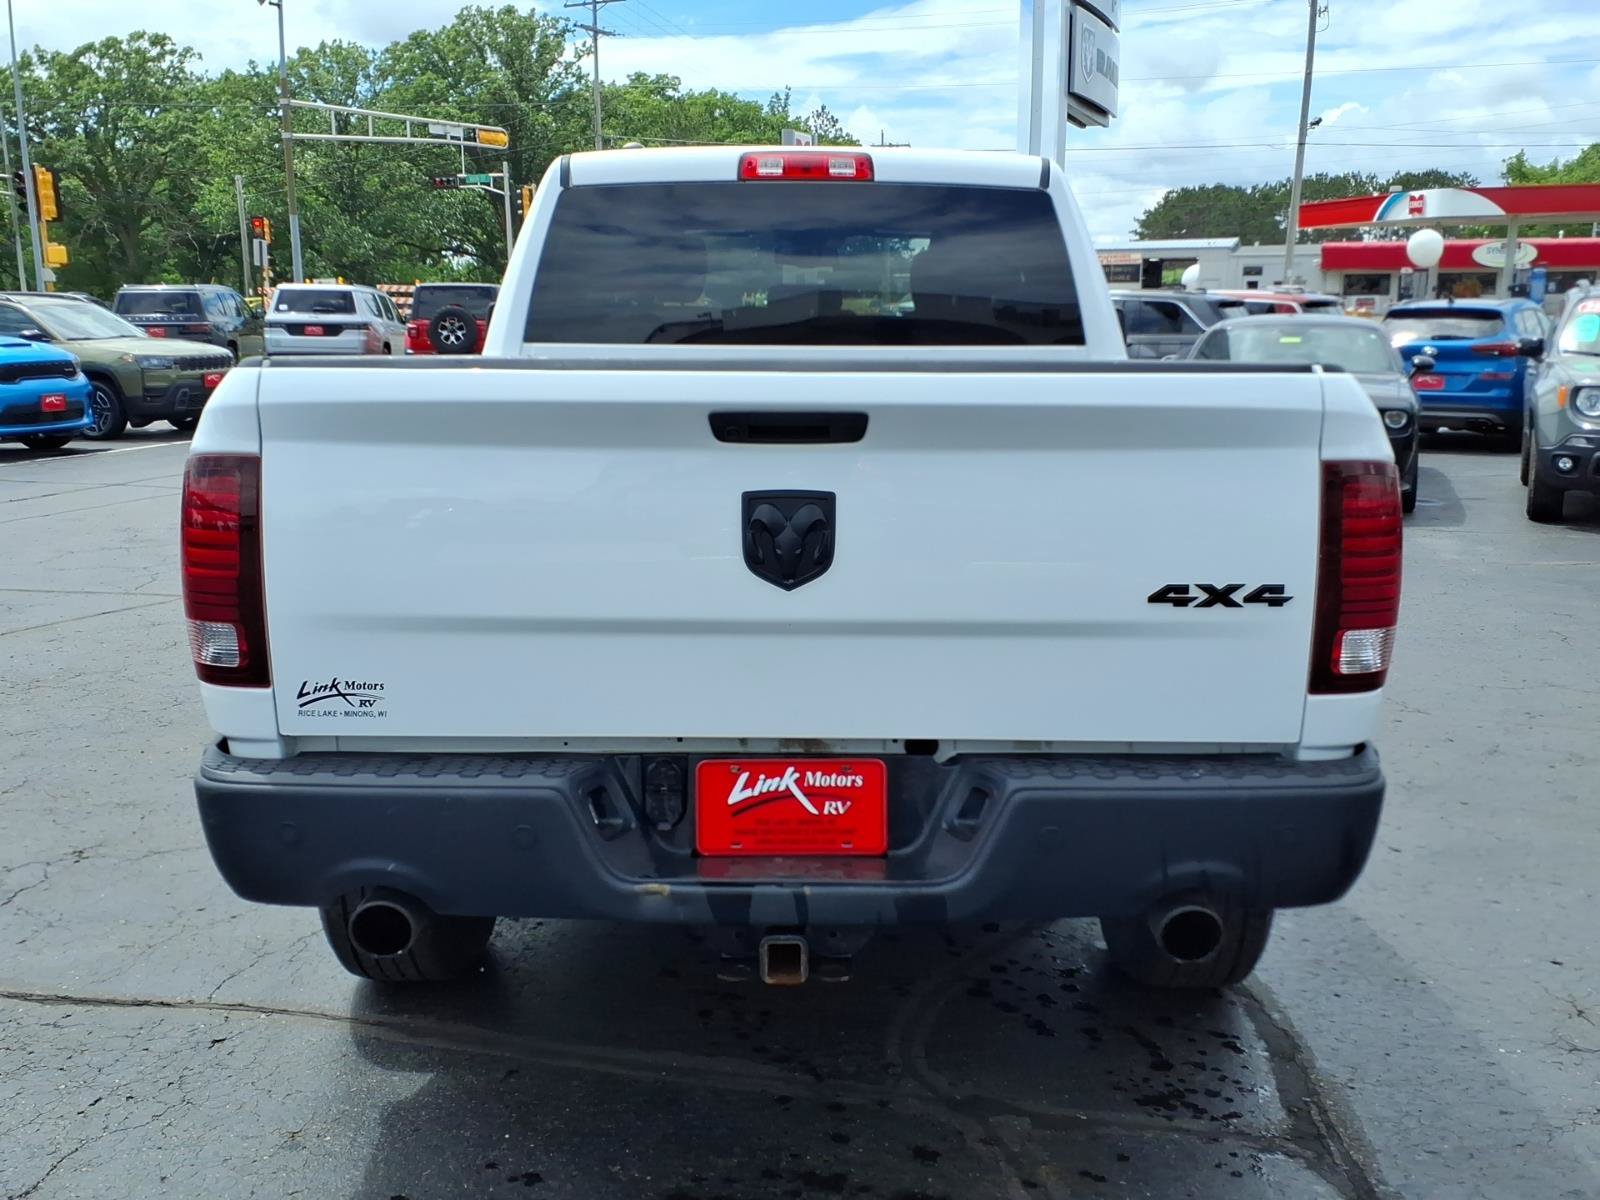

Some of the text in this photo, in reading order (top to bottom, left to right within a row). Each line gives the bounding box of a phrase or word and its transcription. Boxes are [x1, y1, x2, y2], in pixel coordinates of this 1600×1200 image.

[1147, 583, 1294, 608] 4X4
[296, 677, 385, 707] Link Motors
[358, 699, 377, 708] RV
[297, 709, 388, 719] RICE LAKE MINONG, WI
[727, 765, 864, 816] Link Motors
[823, 800, 852, 816] RV
